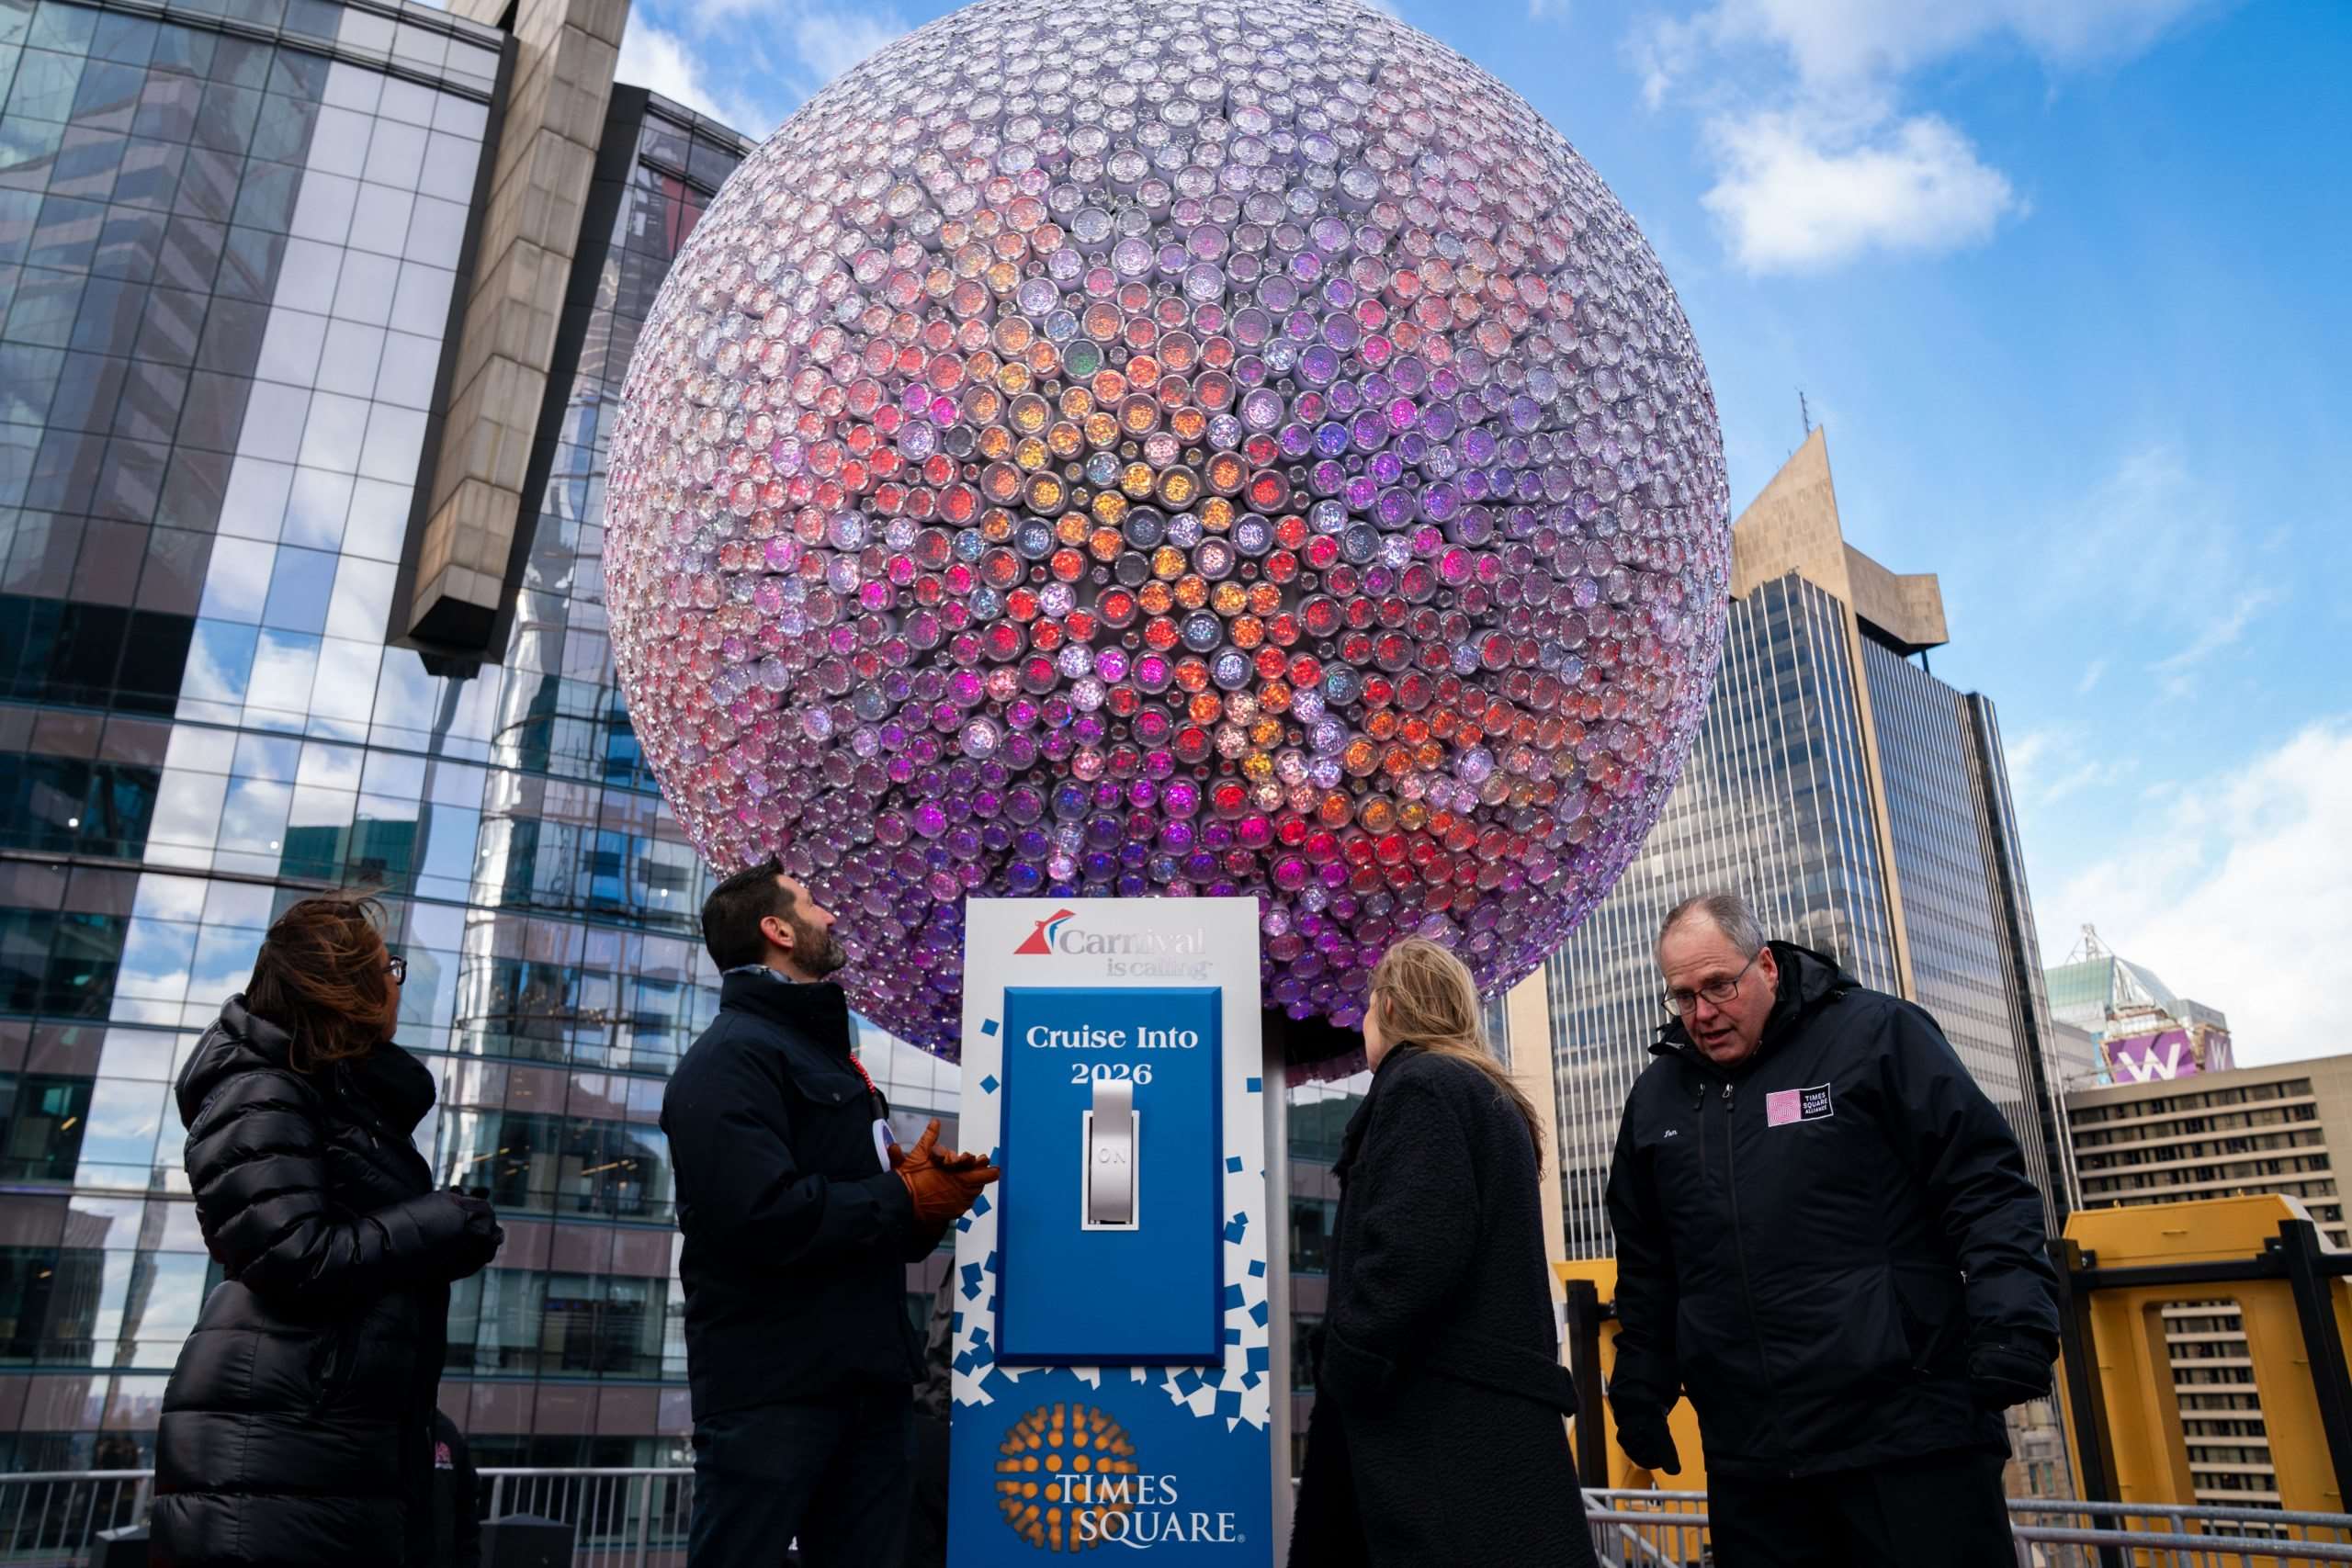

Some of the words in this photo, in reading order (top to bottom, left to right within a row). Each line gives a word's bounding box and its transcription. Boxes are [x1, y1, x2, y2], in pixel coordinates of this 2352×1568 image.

[1058, 928, 1206, 955] Carnival
[1106, 957, 1126, 977] is
[1129, 957, 1210, 980] calling
[1025, 1024, 1126, 1049] Cruise
[1136, 1026, 1199, 1049] Into
[2117, 1043, 2181, 1082] W
[2210, 1039, 2228, 1071] W
[1070, 1063, 1153, 1085] 2026
[1803, 1097, 1828, 1109] SQUARE
[1804, 1091, 1826, 1102] TIMES
[1098, 1147, 1126, 1164] ON
[1056, 1473, 1178, 1505] TIMES
